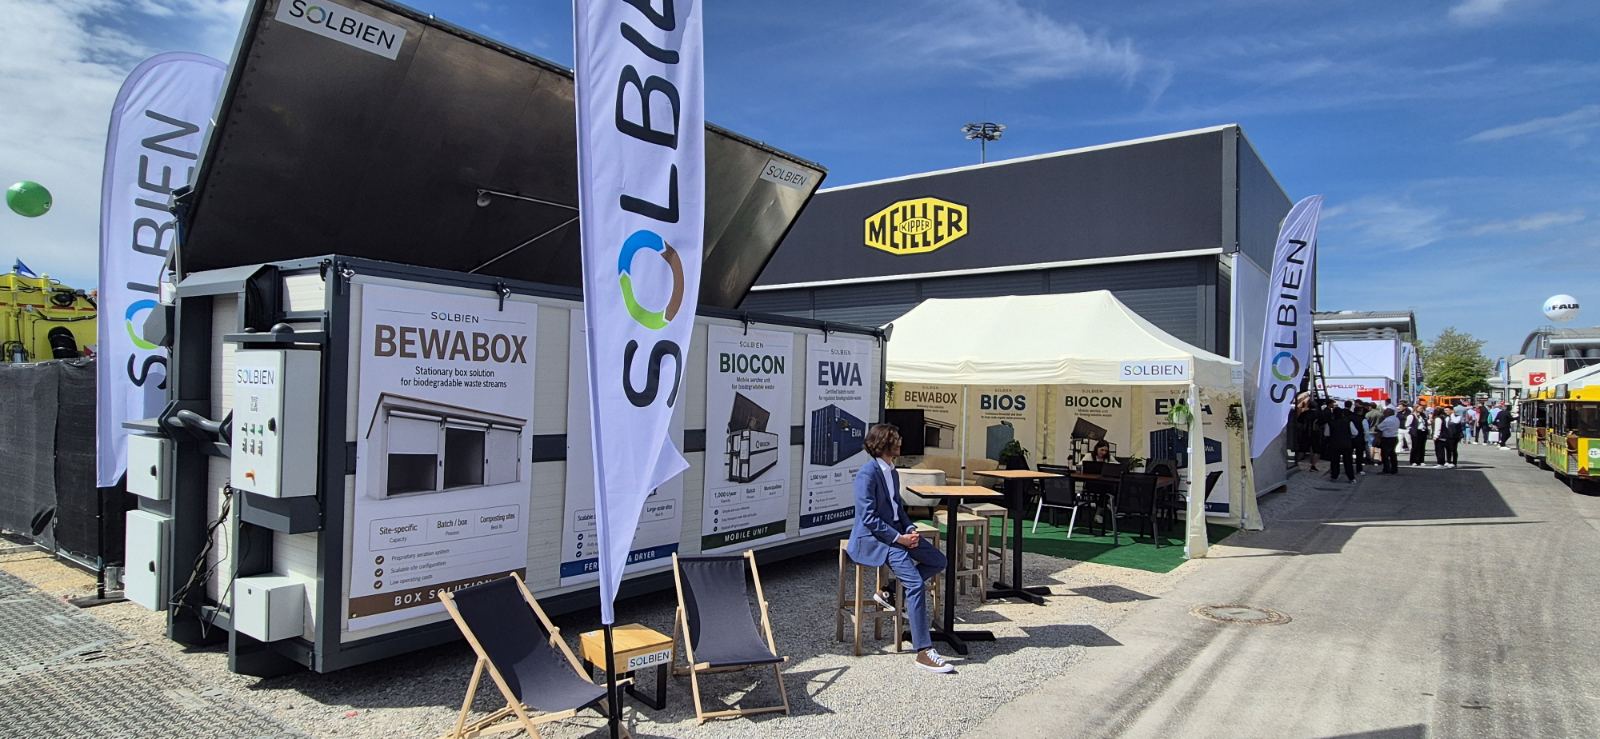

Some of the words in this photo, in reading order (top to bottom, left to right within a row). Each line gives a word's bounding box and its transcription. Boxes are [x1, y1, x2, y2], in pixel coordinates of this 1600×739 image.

[289, 0, 395, 49] SOLBIEN
[767, 166, 807, 185] SOLBIEN
[870, 203, 962, 249] MEILLER
[902, 220, 930, 232] KIPPER
[431, 312, 479, 323] SOLBIEN
[1270, 239, 1307, 405] SOLBIEN
[374, 324, 527, 364] BEWABOX
[720, 353, 784, 374] BIOCON
[1124, 365, 1183, 376] SOLBIEN
[237, 369, 274, 384] SOLBIEN
[416, 366, 453, 378] Stationary
[455, 368, 467, 376] box
[470, 368, 494, 377] solution
[818, 361, 862, 386] EWA
[401, 378, 411, 386] for
[414, 378, 462, 388] biodegradable
[464, 380, 482, 388] waste
[483, 380, 507, 388] streams
[905, 391, 957, 404] BEWABOX
[980, 394, 1026, 410] BIOS
[1065, 396, 1122, 408] BIOCON
[437, 519, 453, 528] Batch
[458, 518, 467, 526] box
[480, 514, 505, 523] Composting
[379, 523, 418, 535] Site-specific
[725, 530, 751, 542] MOBILE
[753, 527, 768, 536] UNIT
[635, 550, 655, 561] DRYER
[394, 592, 422, 606] BOX
[630, 651, 670, 667] SOLBIEN
